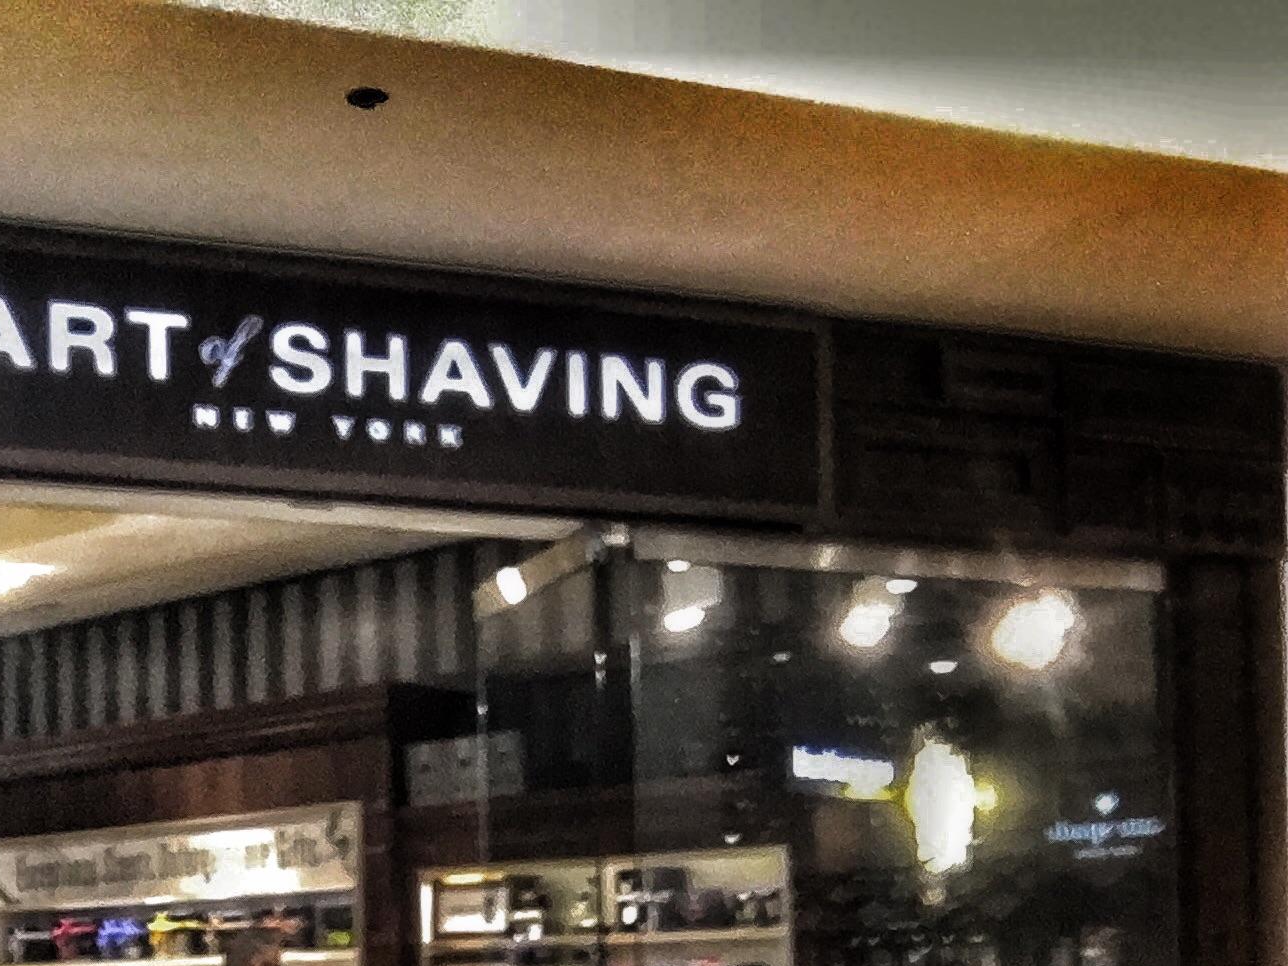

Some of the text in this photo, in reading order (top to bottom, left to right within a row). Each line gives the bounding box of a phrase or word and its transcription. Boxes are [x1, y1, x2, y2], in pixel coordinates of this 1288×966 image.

[198, 314, 265, 388] of
[268, 321, 743, 431] SHAVING
[191, 403, 465, 449] NEW YORK
